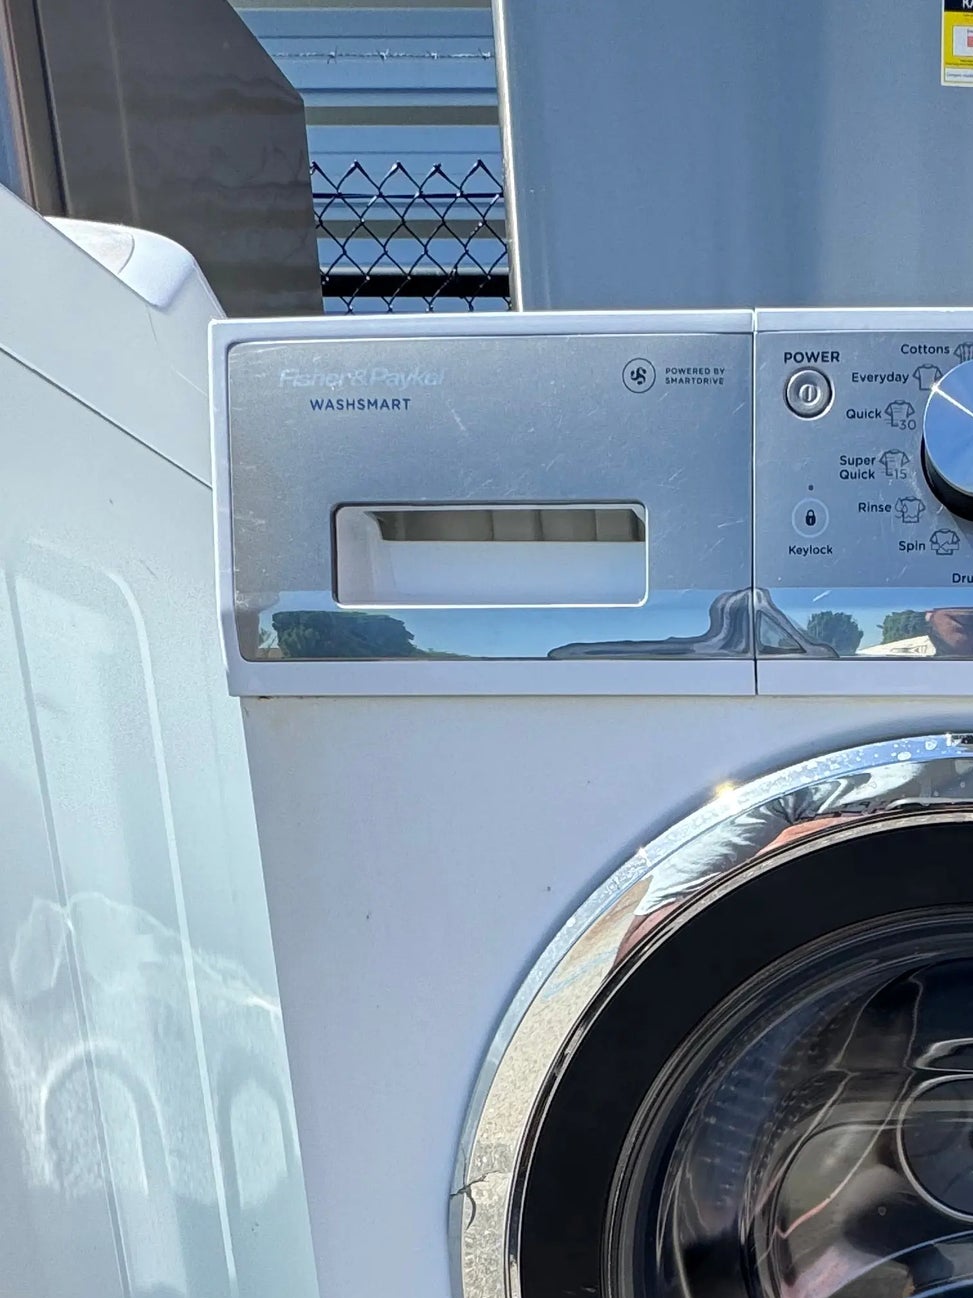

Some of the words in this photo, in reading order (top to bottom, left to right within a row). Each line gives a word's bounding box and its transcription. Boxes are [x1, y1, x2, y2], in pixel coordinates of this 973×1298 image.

[901, 344, 950, 354] Cottons
[783, 352, 840, 363] POWER
[665, 367, 711, 375] POWERED
[713, 367, 725, 375] BY
[852, 372, 909, 384] Everyday
[309, 398, 411, 411] WASHSMART
[846, 409, 882, 421] Quick
[898, 419, 917, 430] 30
[840, 455, 876, 468] Super
[839, 468, 876, 481] Quick
[894, 469, 907, 479] 15
[858, 502, 892, 512] Rinse
[788, 545, 833, 557] Keylock
[898, 541, 926, 553] Spin
